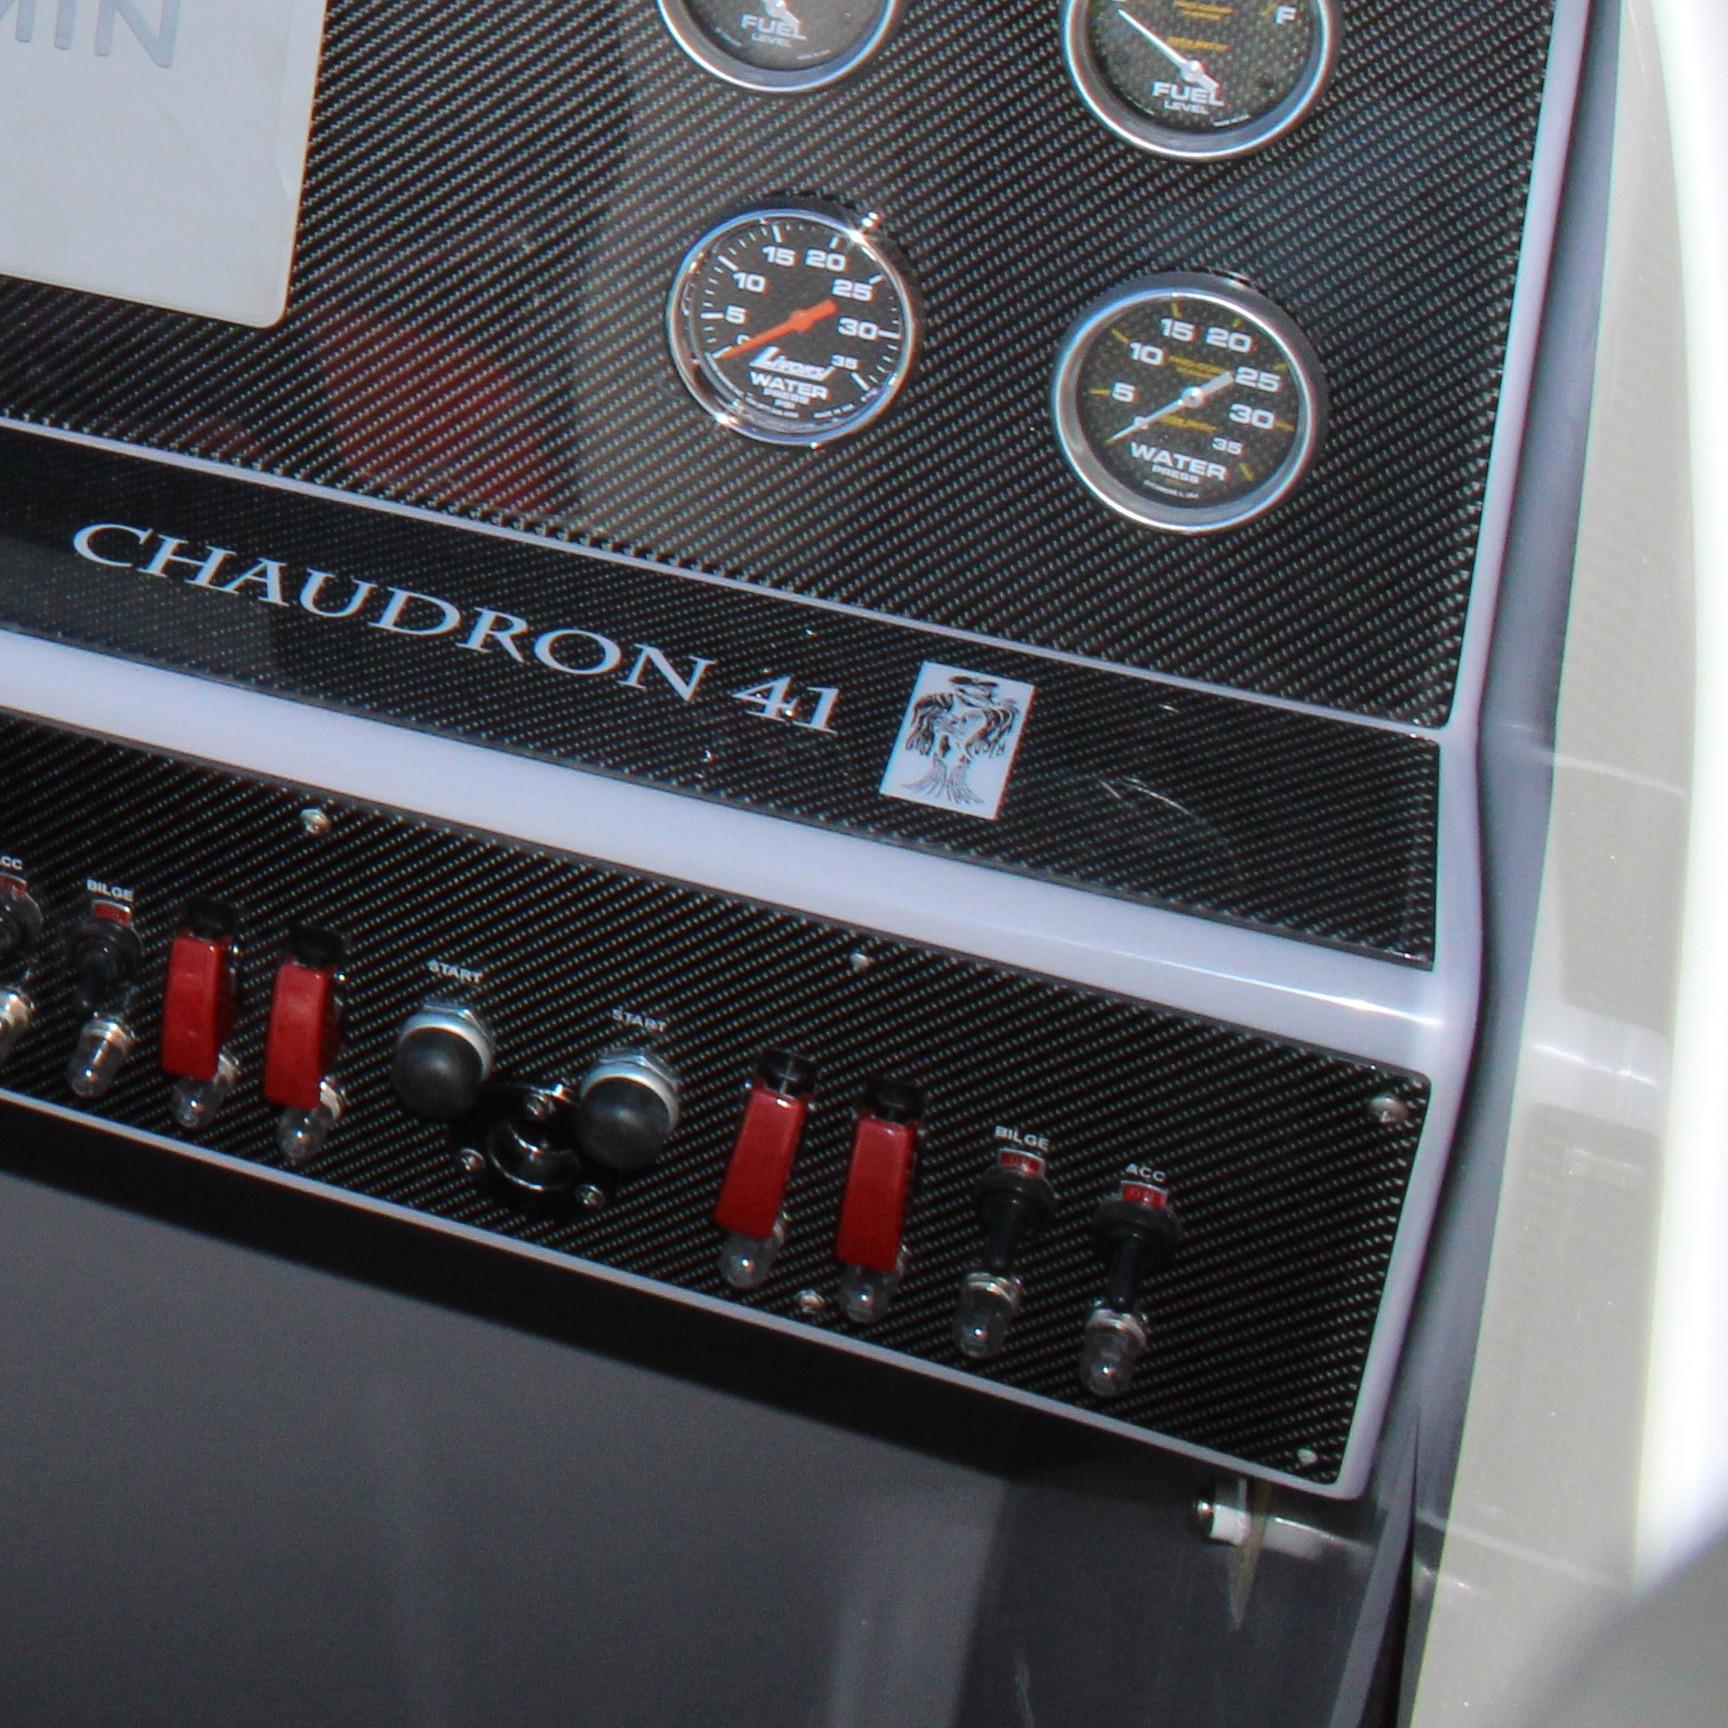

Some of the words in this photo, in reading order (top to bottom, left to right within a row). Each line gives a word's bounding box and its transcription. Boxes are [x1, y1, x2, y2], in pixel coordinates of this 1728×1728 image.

[1275, 5, 1297, 24] F
[741, 14, 807, 41] FUEL
[1152, 80, 1224, 106] FUEL
[1164, 100, 1209, 115] LEVEL
[762, 246, 796, 267] 15
[805, 248, 846, 271] 20
[733, 271, 766, 294] 10
[832, 278, 872, 302] 25
[725, 305, 746, 325] 5
[838, 317, 878, 341] 30
[1161, 318, 1194, 342] 15
[1206, 326, 1253, 353] 20
[831, 353, 858, 371] 35
[1129, 341, 1164, 366] 10
[749, 370, 828, 401] WATER
[1235, 366, 1281, 393] 25
[1111, 382, 1136, 403] 5
[1228, 403, 1275, 430] 30
[1212, 436, 1243, 455] 35
[1130, 441, 1227, 482] WATER
[1152, 463, 1200, 484] PRESS
[72, 522, 715, 703] CHAUDRON
[731, 674, 839, 734] 41
[87, 877, 134, 902] BILGE
[427, 958, 483, 983] START
[612, 1007, 668, 1033] START
[995, 1125, 1050, 1151] BILGE
[1125, 1163, 1166, 1182] ACC
